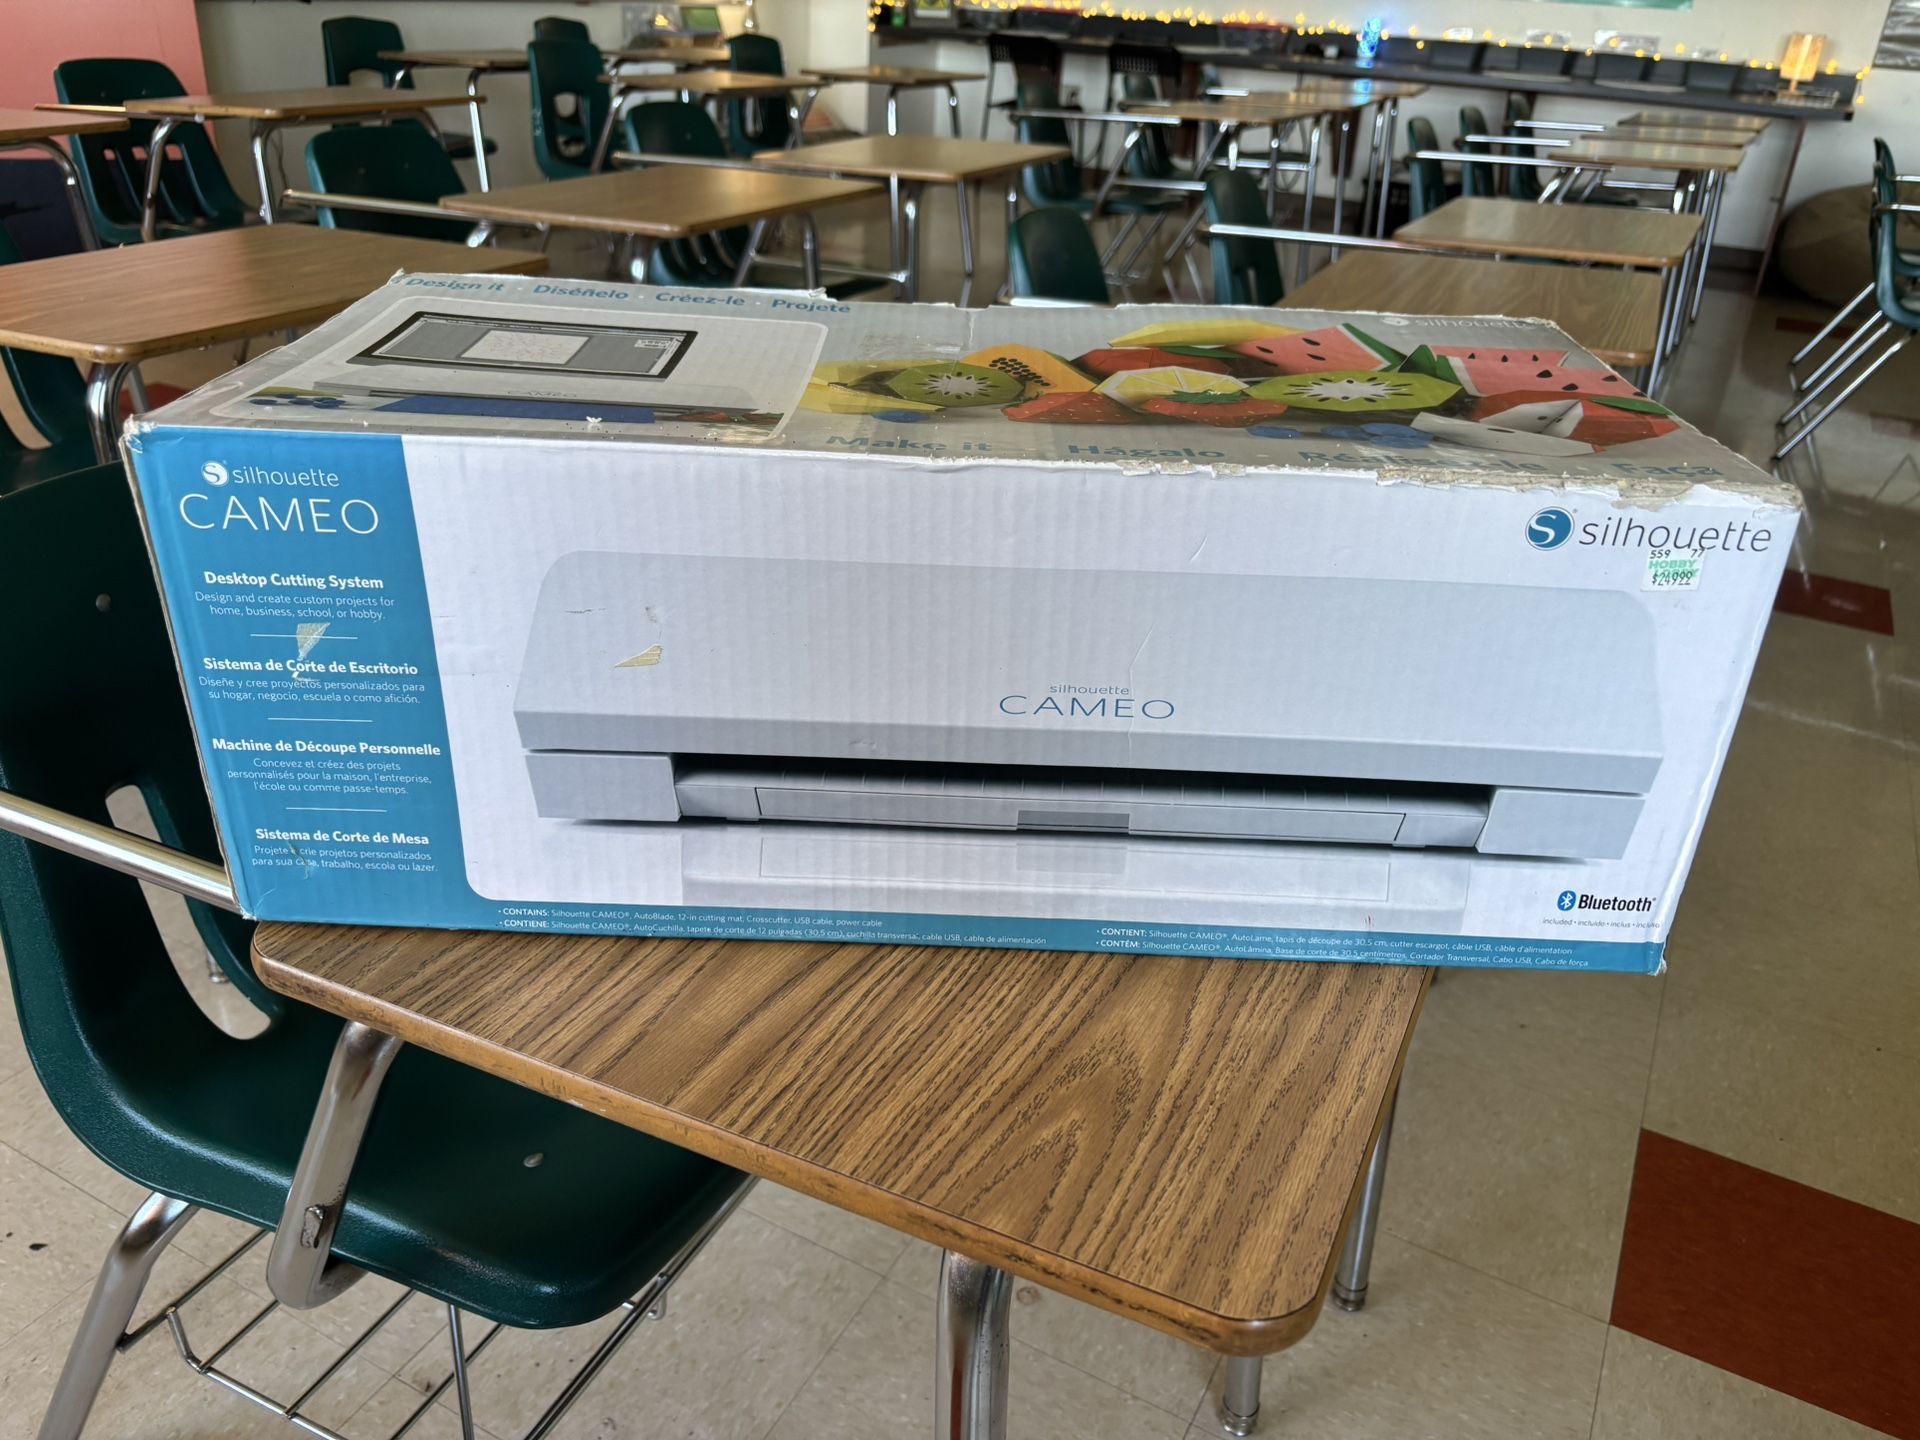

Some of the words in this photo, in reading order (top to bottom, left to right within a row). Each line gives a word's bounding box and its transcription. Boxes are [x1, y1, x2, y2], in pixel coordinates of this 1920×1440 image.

[407, 278, 482, 290] Design
[488, 281, 504, 290] it
[533, 284, 629, 300] Diséñelo
[656, 291, 745, 306] Créez-le
[825, 436, 947, 450] Make
[963, 442, 992, 451] it
[1611, 463, 1724, 477] Faça
[232, 467, 340, 487] silhouette
[179, 493, 379, 534] CAMEO
[1579, 517, 1772, 552] silhouette
[1650, 549, 1671, 559] 559
[1648, 559, 1697, 569] HOBBY
[204, 571, 267, 588] Desktop
[270, 573, 326, 590] Cutting
[329, 575, 384, 590] System
[195, 591, 233, 604] Design
[235, 592, 255, 603] and
[257, 594, 291, 604] create
[293, 595, 333, 605] custom
[336, 596, 378, 608] projects
[380, 596, 395, 606] for
[210, 605, 244, 617] home,
[246, 606, 295, 618] business,
[297, 607, 334, 619] school,
[336, 610, 347, 618] or
[350, 608, 386, 622] hobby.
[203, 657, 262, 671] Sistema
[265, 659, 283, 671] de
[287, 660, 326, 674] Corte
[329, 661, 347, 673] de
[349, 662, 418, 676] Escritorio
[198, 676, 234, 687] Diseñe
[237, 680, 243, 689] y
[246, 680, 268, 688] cree
[270, 679, 322, 691] proyectos
[324, 680, 399, 693] personalizados
[402, 684, 425, 693] para
[1049, 684, 1129, 695] silhouette
[208, 691, 220, 699] su
[222, 690, 255, 702] hogar,
[258, 692, 301, 703] negocio,
[303, 692, 341, 702] escuela
[353, 694, 381, 703] como
[384, 694, 421, 705] afición.
[1000, 695, 1175, 719] CAMEO
[212, 738, 272, 752] Machine
[275, 740, 293, 752] de
[295, 741, 357, 755] Découpe
[359, 743, 441, 756] Personnelle
[253, 758, 302, 768] Concevez
[305, 760, 314, 768] et
[318, 760, 344, 769] créez
[347, 761, 364, 769] des
[367, 762, 401, 771] projets
[227, 770, 294, 781] personnalisés
[297, 772, 319, 781] pour
[322, 771, 331, 780] la
[334, 772, 372, 783] maison,
[253, 782, 285, 791] l'école
[304, 784, 340, 792] comme
[343, 785, 408, 795] passe-temps.
[255, 828, 310, 841] Sistema
[313, 830, 330, 841] de
[332, 831, 370, 843] Corte
[372, 832, 390, 843] de
[392, 833, 430, 845] Mesa
[254, 845, 288, 855] Projete
[319, 848, 358, 858] projetos
[360, 850, 432, 861] personalizados
[252, 858, 273, 866] para
[321, 860, 363, 870] trabalho,
[365, 862, 396, 870] escola
[412, 863, 439, 872] lazer.
[503, 908, 549, 917] CONTAINS:
[551, 910, 590, 918] Silhouette
[698, 914, 725, 924] cutting
[836, 919, 859, 927] power
[861, 920, 882, 928] cable
[504, 919, 549, 928] CONTIENE:
[551, 921, 590, 930] Silhouette
[714, 926, 723, 934] de
[768, 928, 803, 937] pulgadas
[964, 935, 984, 943] cable
[997, 936, 1046, 945] alimentación
[1101, 928, 1147, 937] CONTIENT:
[1149, 930, 1187, 939] Silhouette
[1100, 938, 1140, 948] CONTÉM:
[1142, 941, 1180, 950] Silhouette
[1409, 951, 1444, 960] Cortador
[1493, 955, 1513, 963] Cabo
[1535, 957, 1555, 965] Cabo
